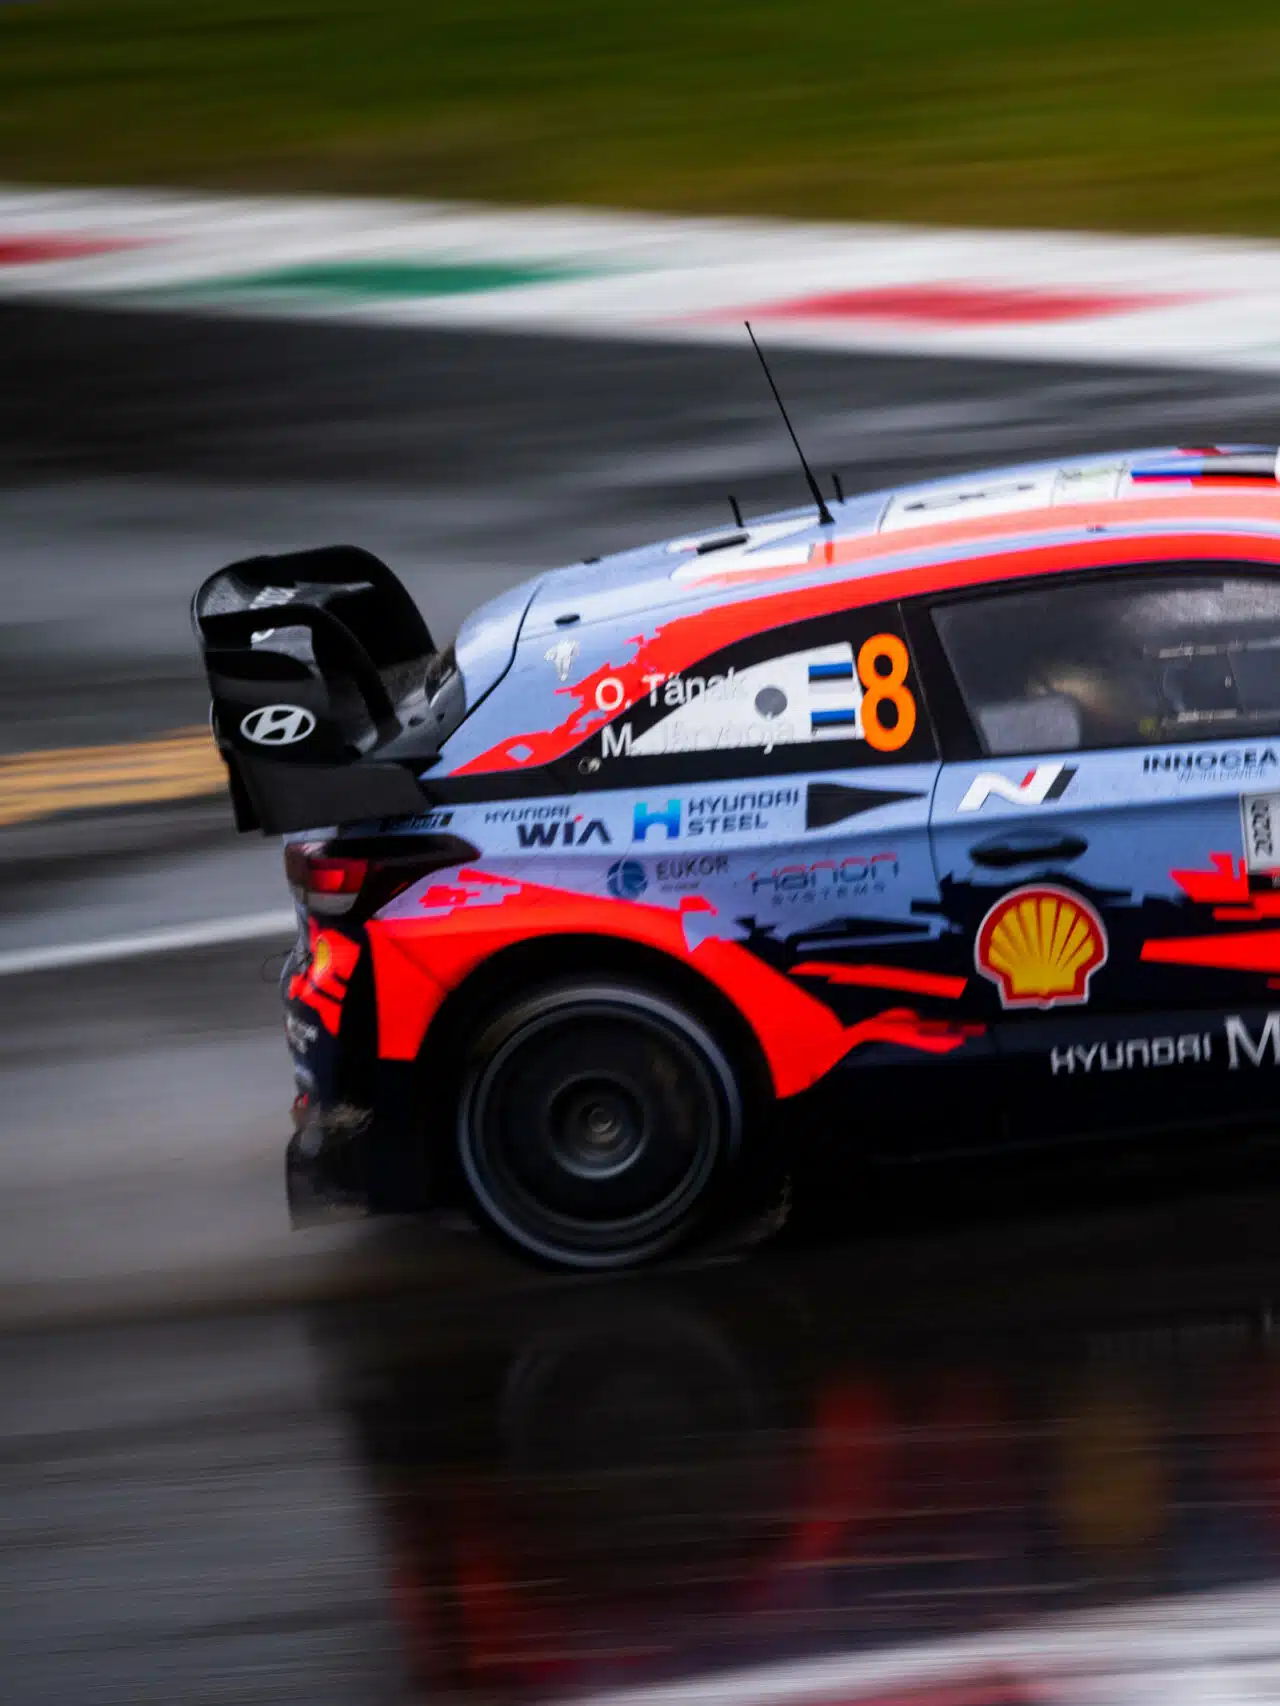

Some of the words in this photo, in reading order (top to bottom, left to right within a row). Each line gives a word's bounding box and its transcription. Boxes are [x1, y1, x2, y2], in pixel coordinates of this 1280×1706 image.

[595, 676, 631, 711] O.
[857, 632, 917, 752] 8
[484, 804, 571, 824] HYUNDAI
[687, 788, 800, 816] HYUNDAI
[687, 810, 770, 837] STEEL
[655, 855, 730, 881] EUKOR
[1050, 1032, 1212, 1076] HYUNDAI
